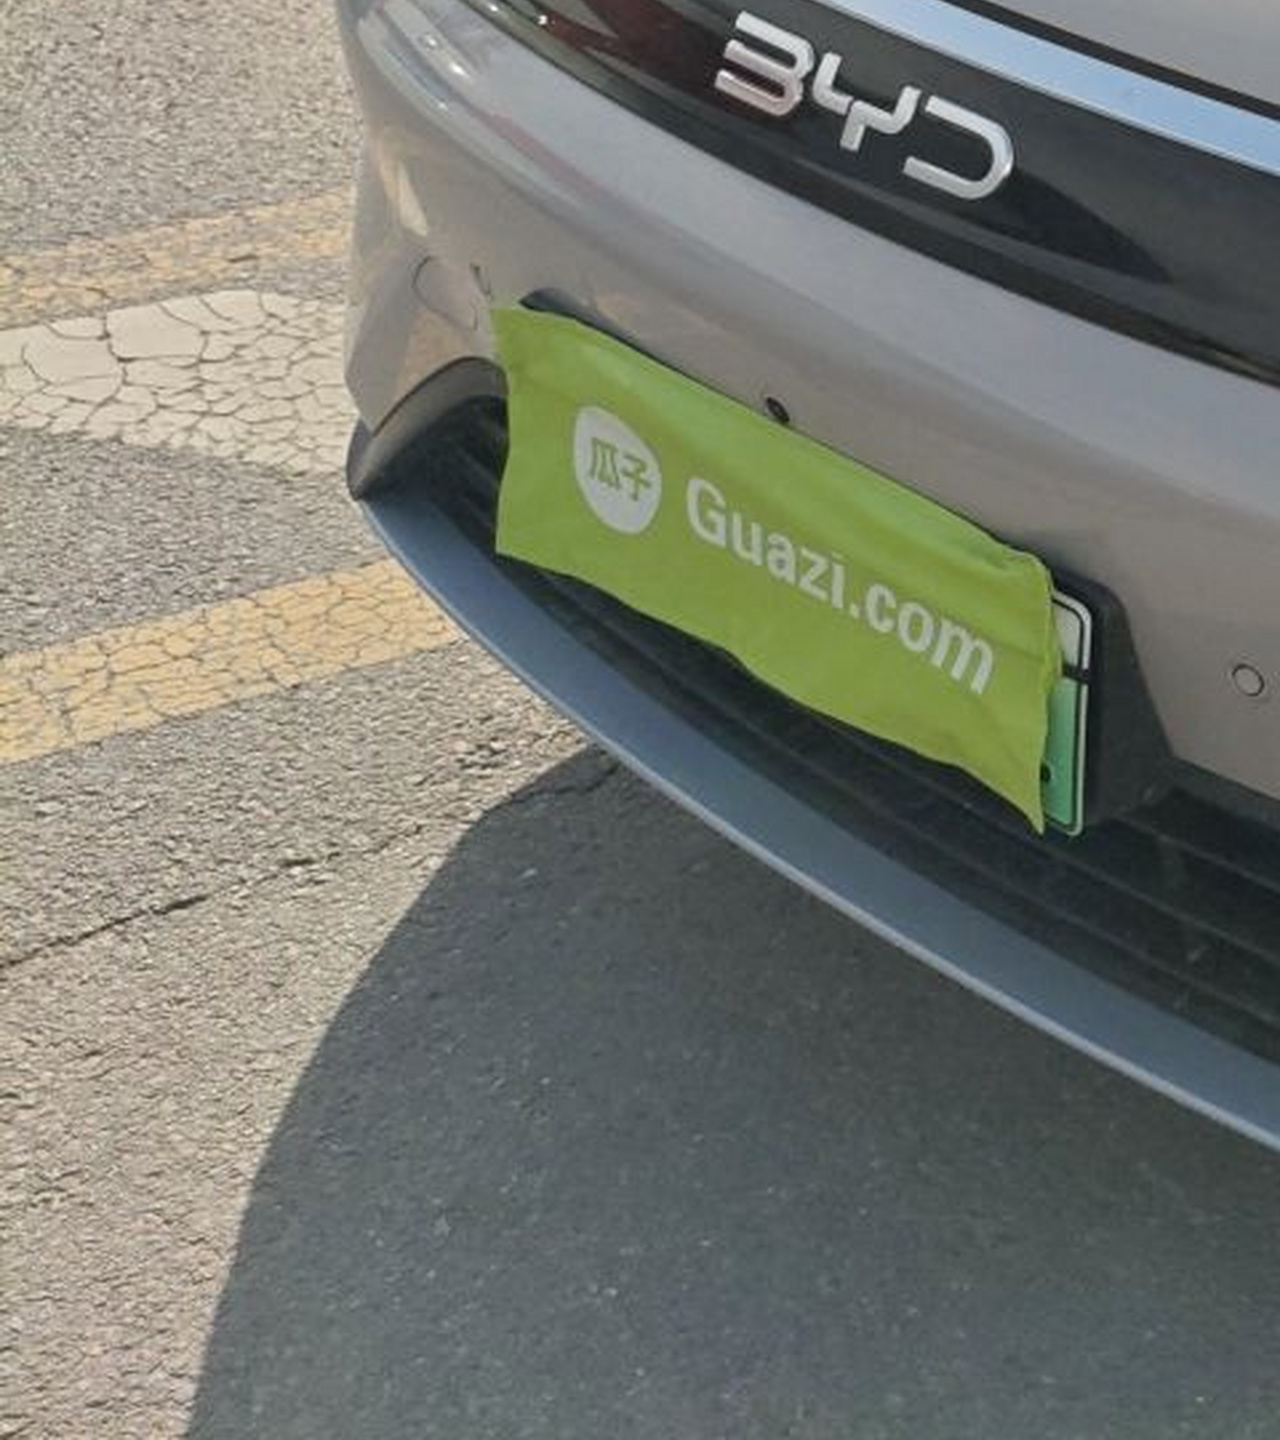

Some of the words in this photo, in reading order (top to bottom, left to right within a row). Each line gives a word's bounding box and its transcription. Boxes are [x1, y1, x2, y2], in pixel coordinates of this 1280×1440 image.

[714, 10, 1014, 200] BYD
[589, 437, 652, 501] 瓜子
[686, 476, 994, 696] Guazi.com
